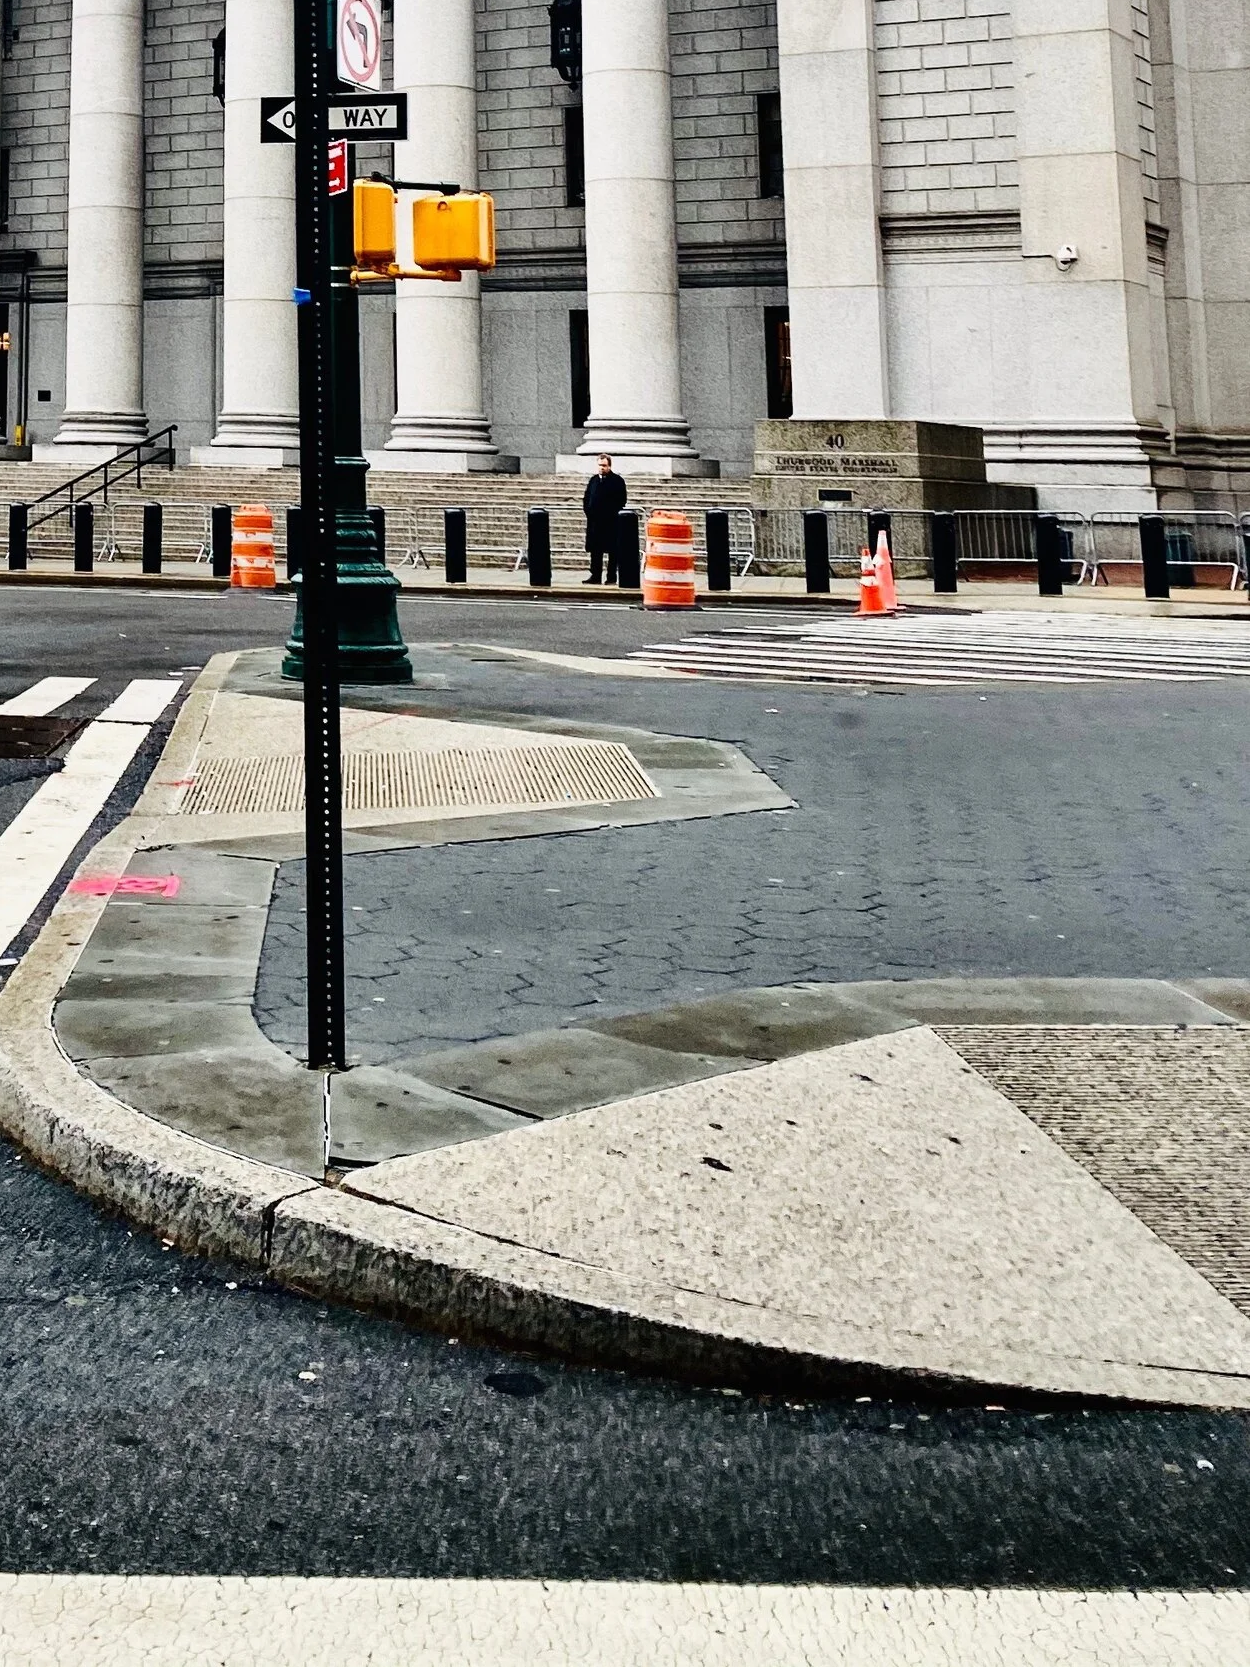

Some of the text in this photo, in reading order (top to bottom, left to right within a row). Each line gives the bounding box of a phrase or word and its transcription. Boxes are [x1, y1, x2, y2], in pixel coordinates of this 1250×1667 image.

[343, 107, 388, 128] WAY
[825, 433, 845, 449] 40
[776, 455, 899, 467] THURGOOD MARSHALL
